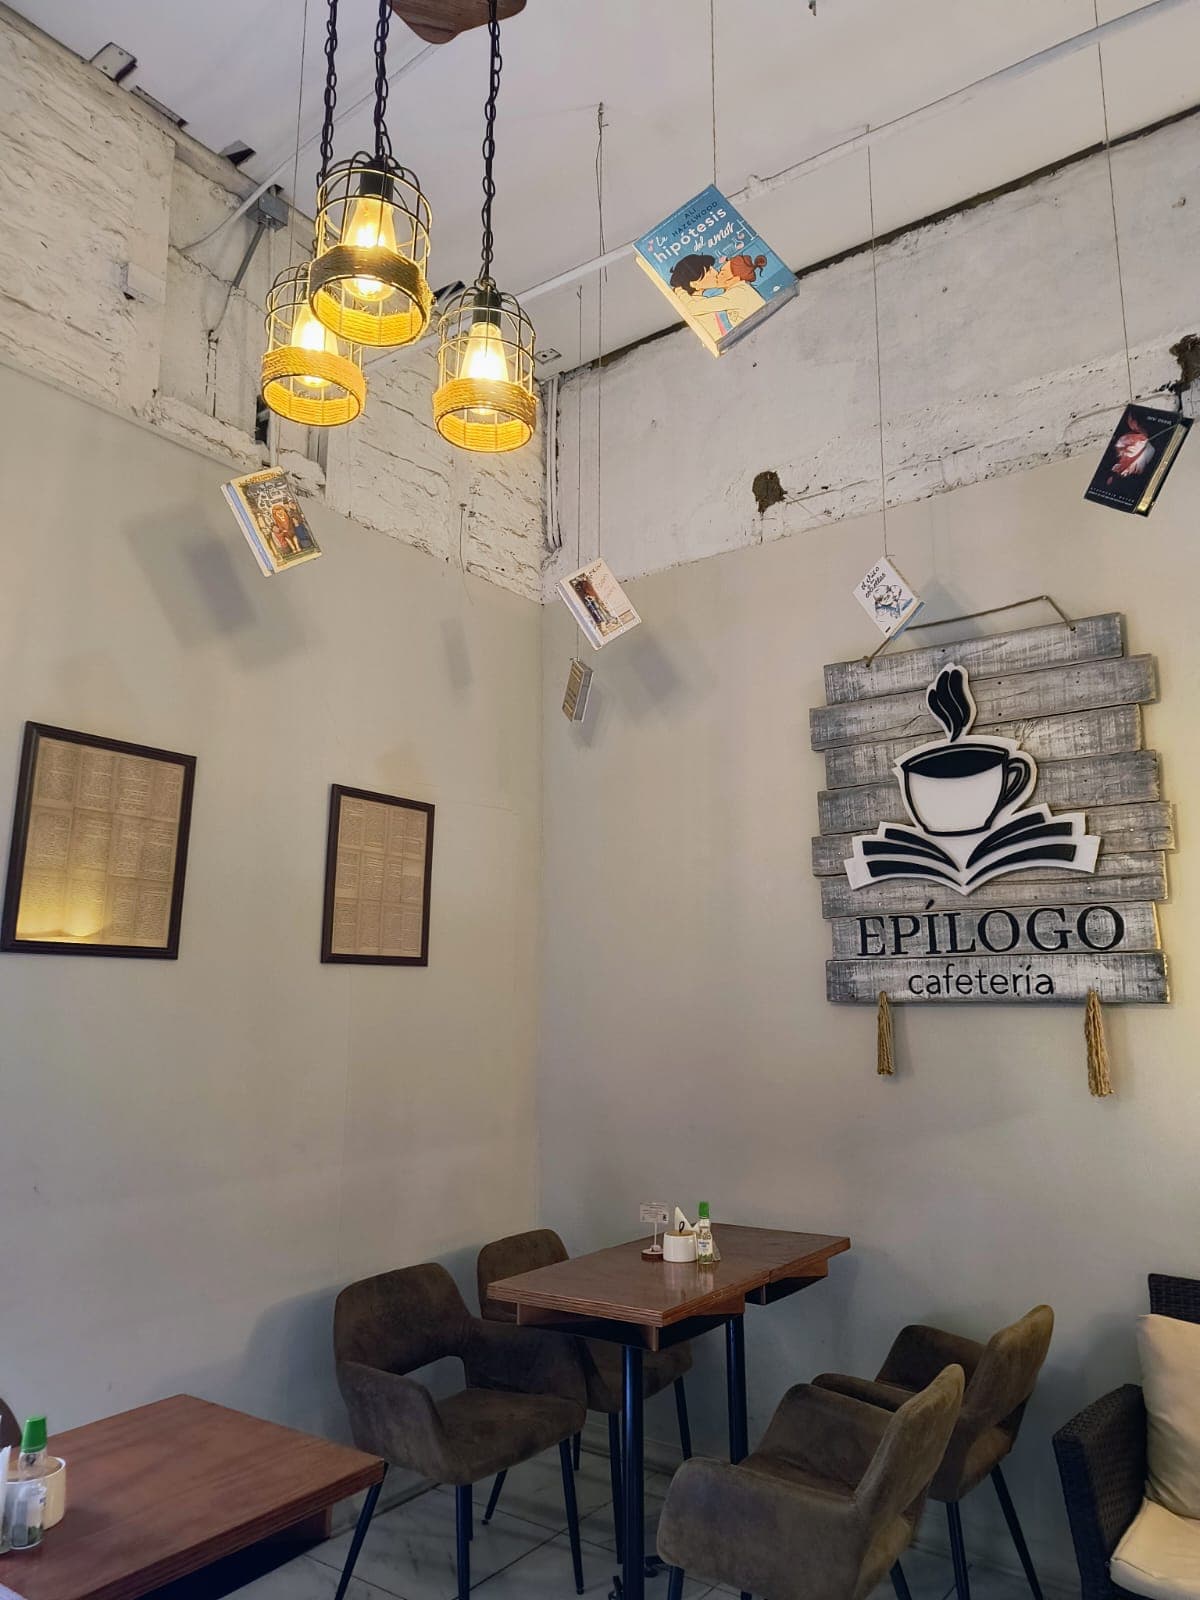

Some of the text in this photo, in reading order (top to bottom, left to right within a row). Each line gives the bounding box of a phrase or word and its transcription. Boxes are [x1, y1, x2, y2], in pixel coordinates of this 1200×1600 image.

[672, 201, 718, 237] HAZELWOOD
[684, 208, 697, 219] ALI
[653, 208, 727, 263] hipótesis
[707, 222, 735, 248] amor
[856, 899, 1125, 957] EPÍLOGO
[908, 963, 1055, 996] cafetería
